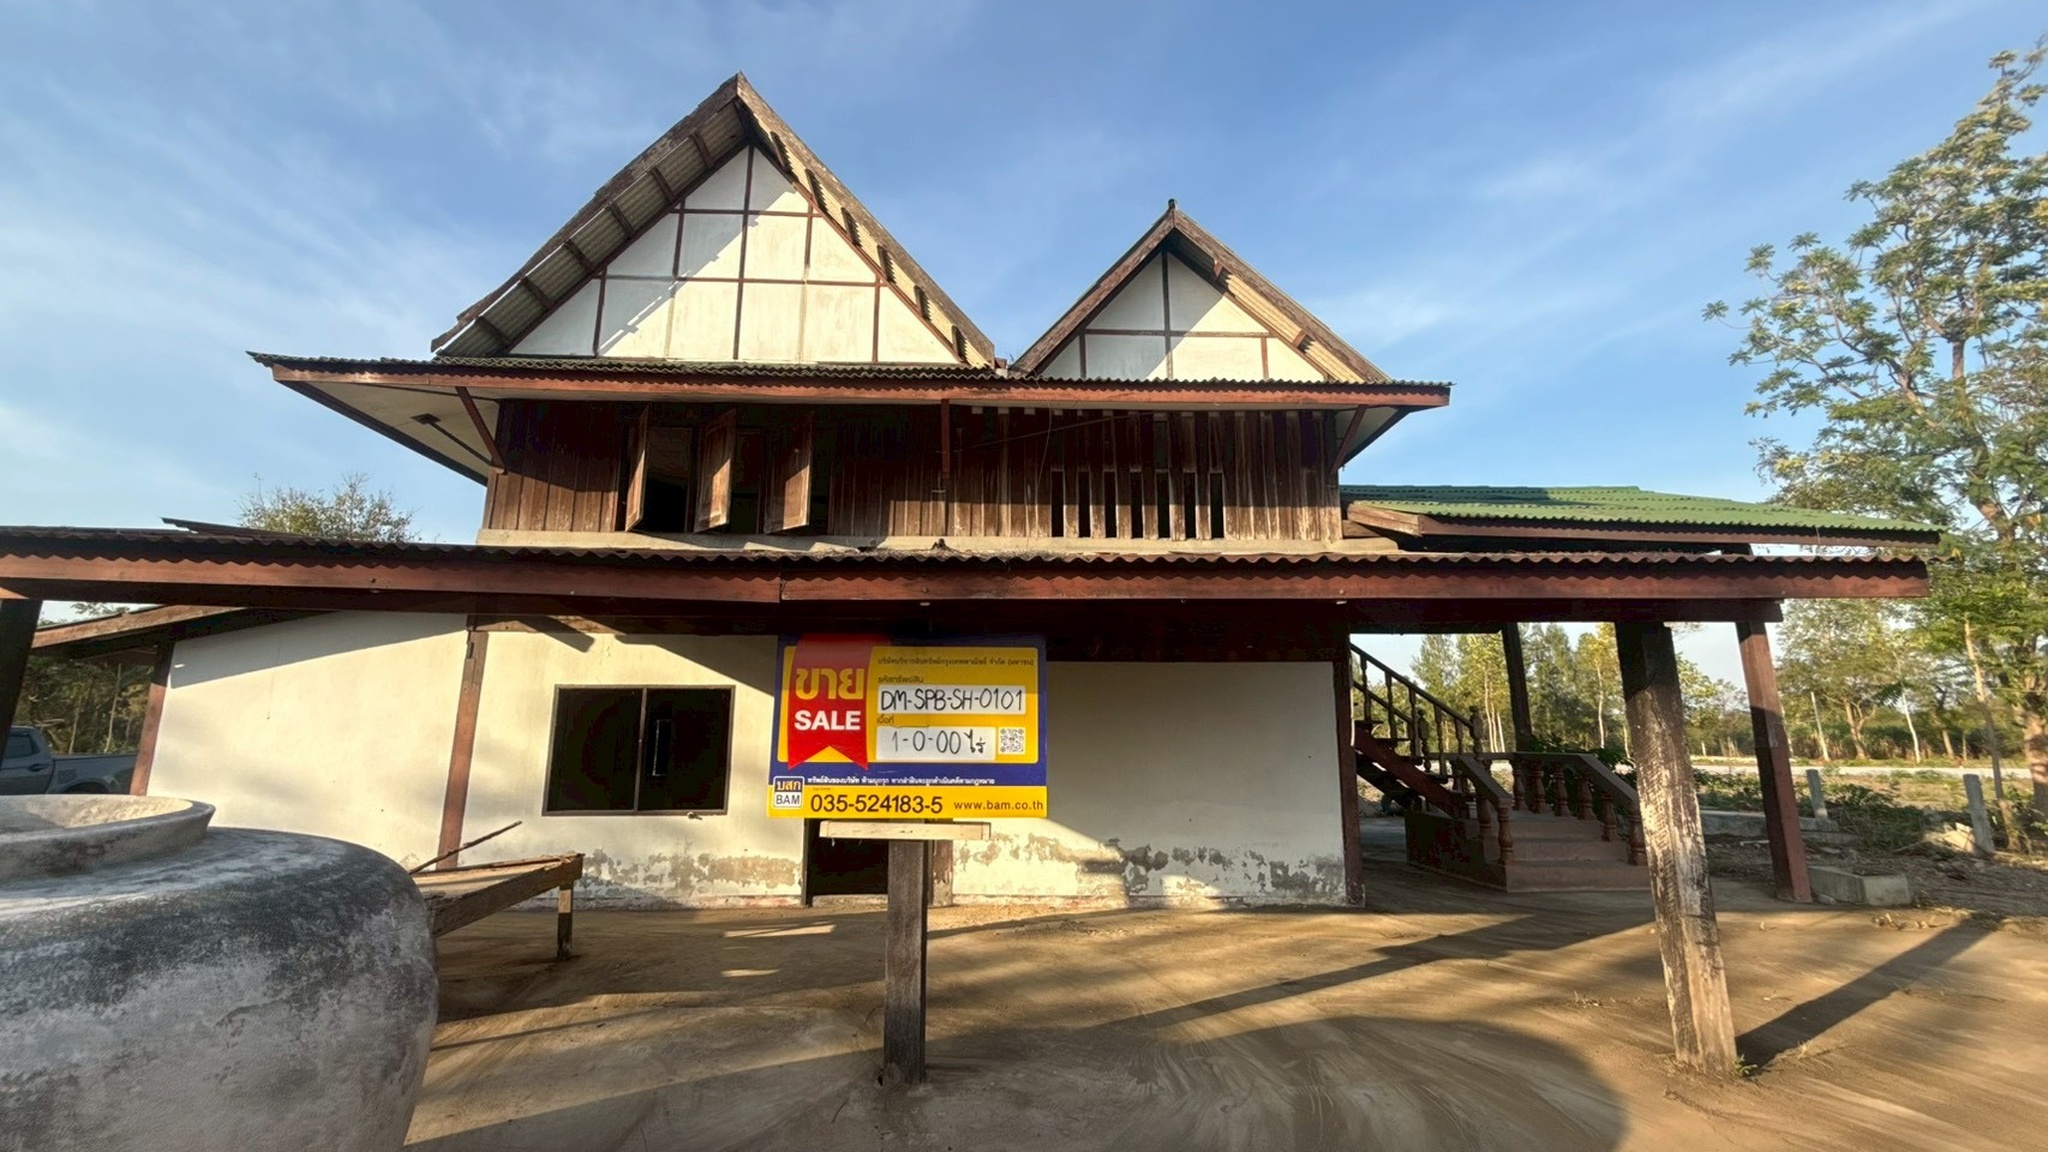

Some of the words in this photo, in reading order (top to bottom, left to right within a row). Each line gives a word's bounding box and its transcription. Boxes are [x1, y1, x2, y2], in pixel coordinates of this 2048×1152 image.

[795, 668, 863, 699] ขาย
[881, 688, 1022, 711] DM-SPB-SH-0101
[794, 710, 861, 731] SALE
[776, 780, 801, 791] บสก
[776, 794, 800, 805] BAM
[810, 794, 943, 814] 035-524183-5
[954, 800, 1044, 811] www.bam.co.th
